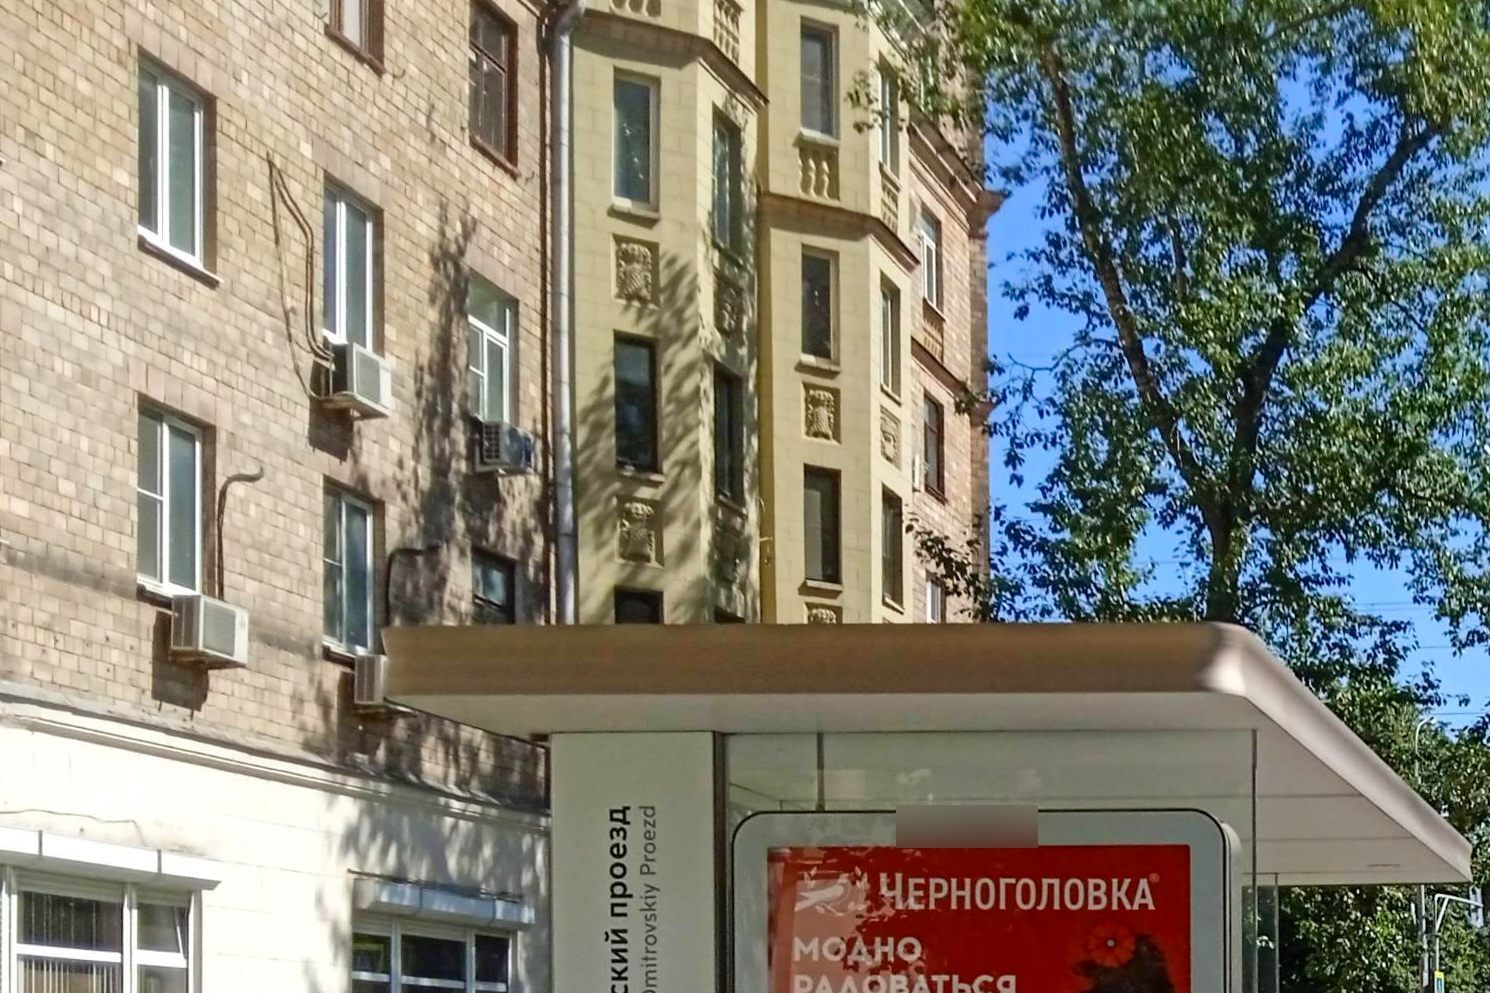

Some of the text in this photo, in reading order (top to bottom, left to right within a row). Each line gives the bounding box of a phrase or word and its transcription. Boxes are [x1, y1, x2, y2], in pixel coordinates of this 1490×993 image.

[603, 805, 635, 917] проезд
[638, 805, 658, 874] Proezd
[879, 872, 1156, 911] ЧЕРНОГОЛОВКА
[793, 936, 923, 964] МОДНО
